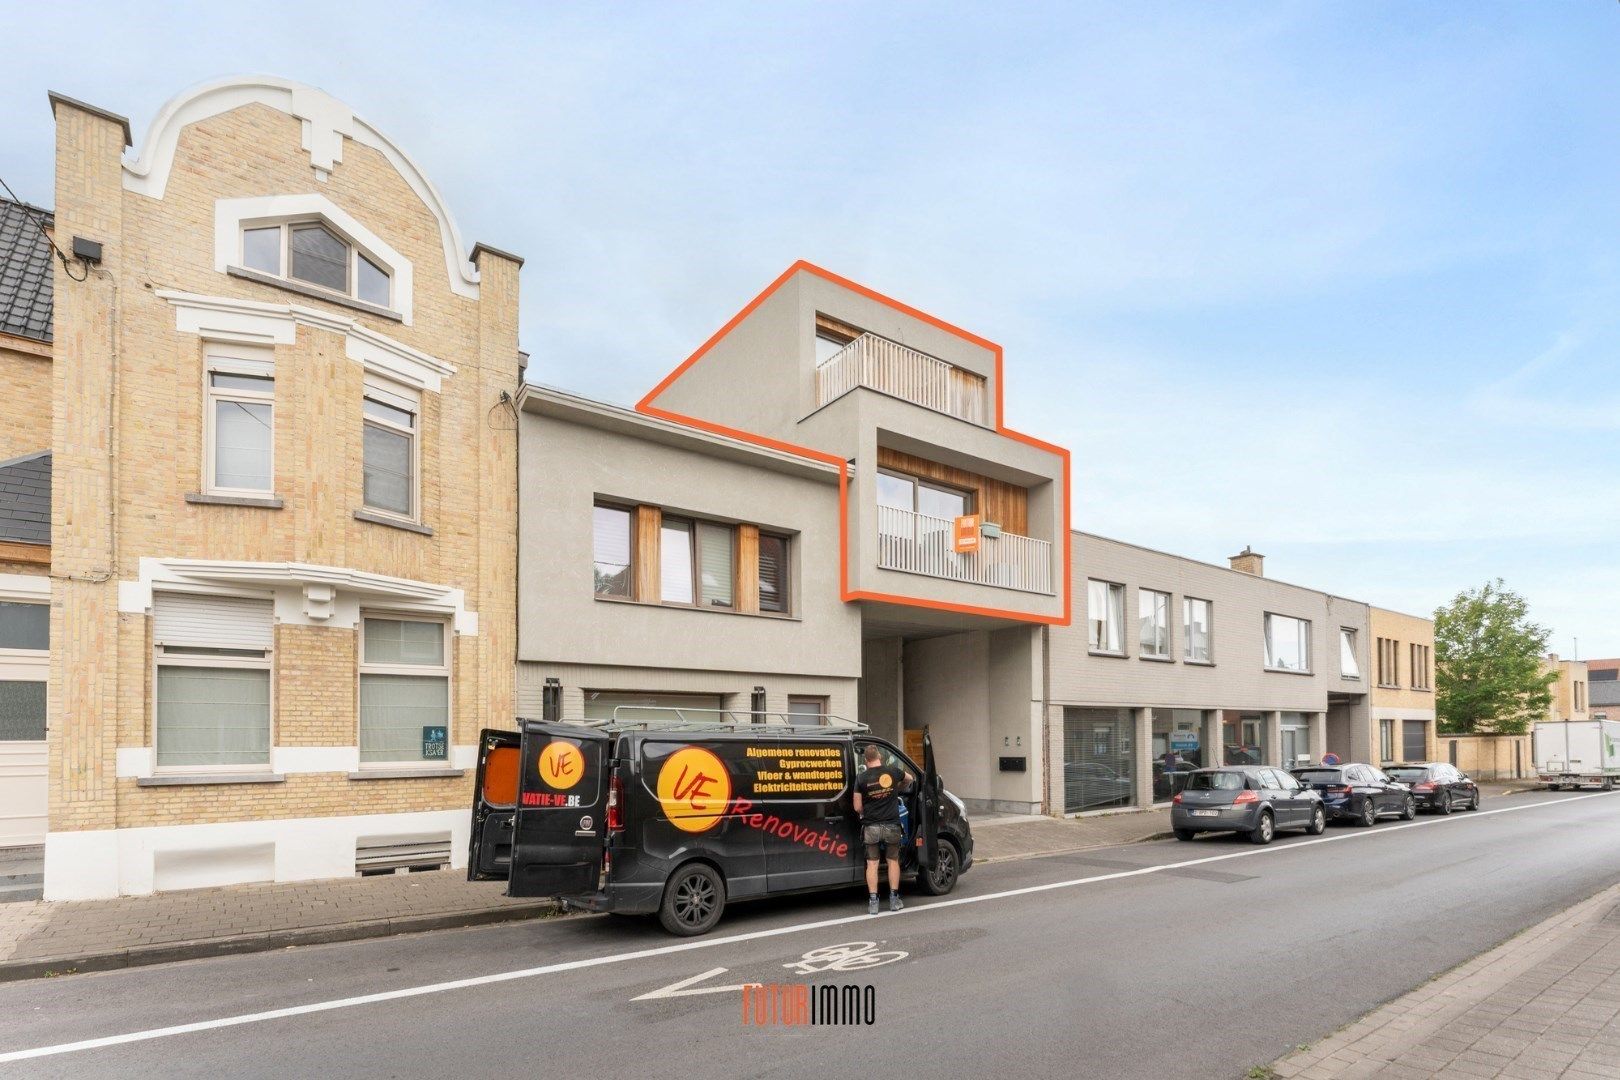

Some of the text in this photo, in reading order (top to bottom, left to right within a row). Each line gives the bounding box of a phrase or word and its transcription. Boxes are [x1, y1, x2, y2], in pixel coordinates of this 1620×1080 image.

[746, 748, 840, 757] Algemene renovaties
[549, 752, 573, 777] VE
[779, 759, 842, 769] Gyprocwerken
[757, 770, 843, 780] Vloer & wandtegels
[754, 781, 844, 792] Elektriciteitswerken
[673, 764, 848, 857] VE Renovatie
